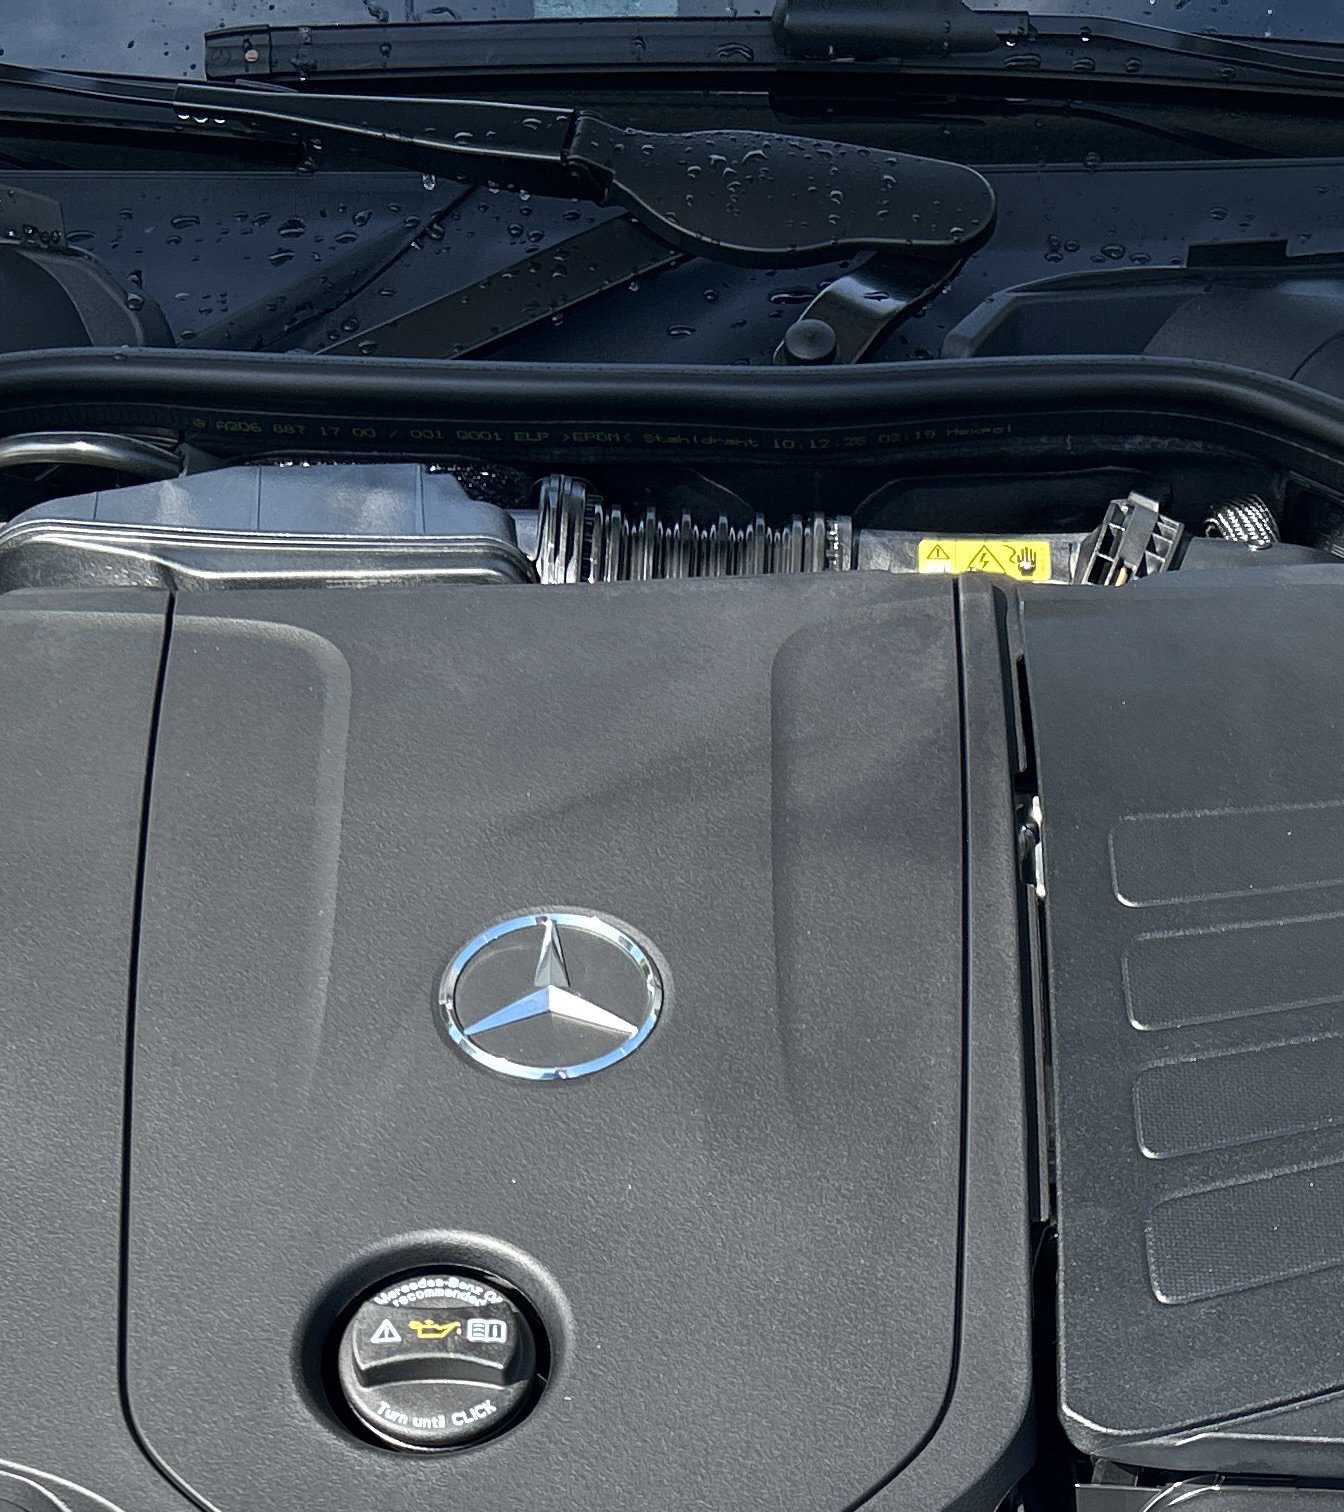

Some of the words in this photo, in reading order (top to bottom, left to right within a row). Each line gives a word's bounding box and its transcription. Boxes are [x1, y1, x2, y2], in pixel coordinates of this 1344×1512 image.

[215, 419, 263, 433] A206
[272, 423, 305, 435] 887
[320, 425, 340, 437] 17
[376, 1400, 407, 1425] Turn
[412, 1415, 446, 1429] until
[451, 1399, 497, 1426] CLICK
